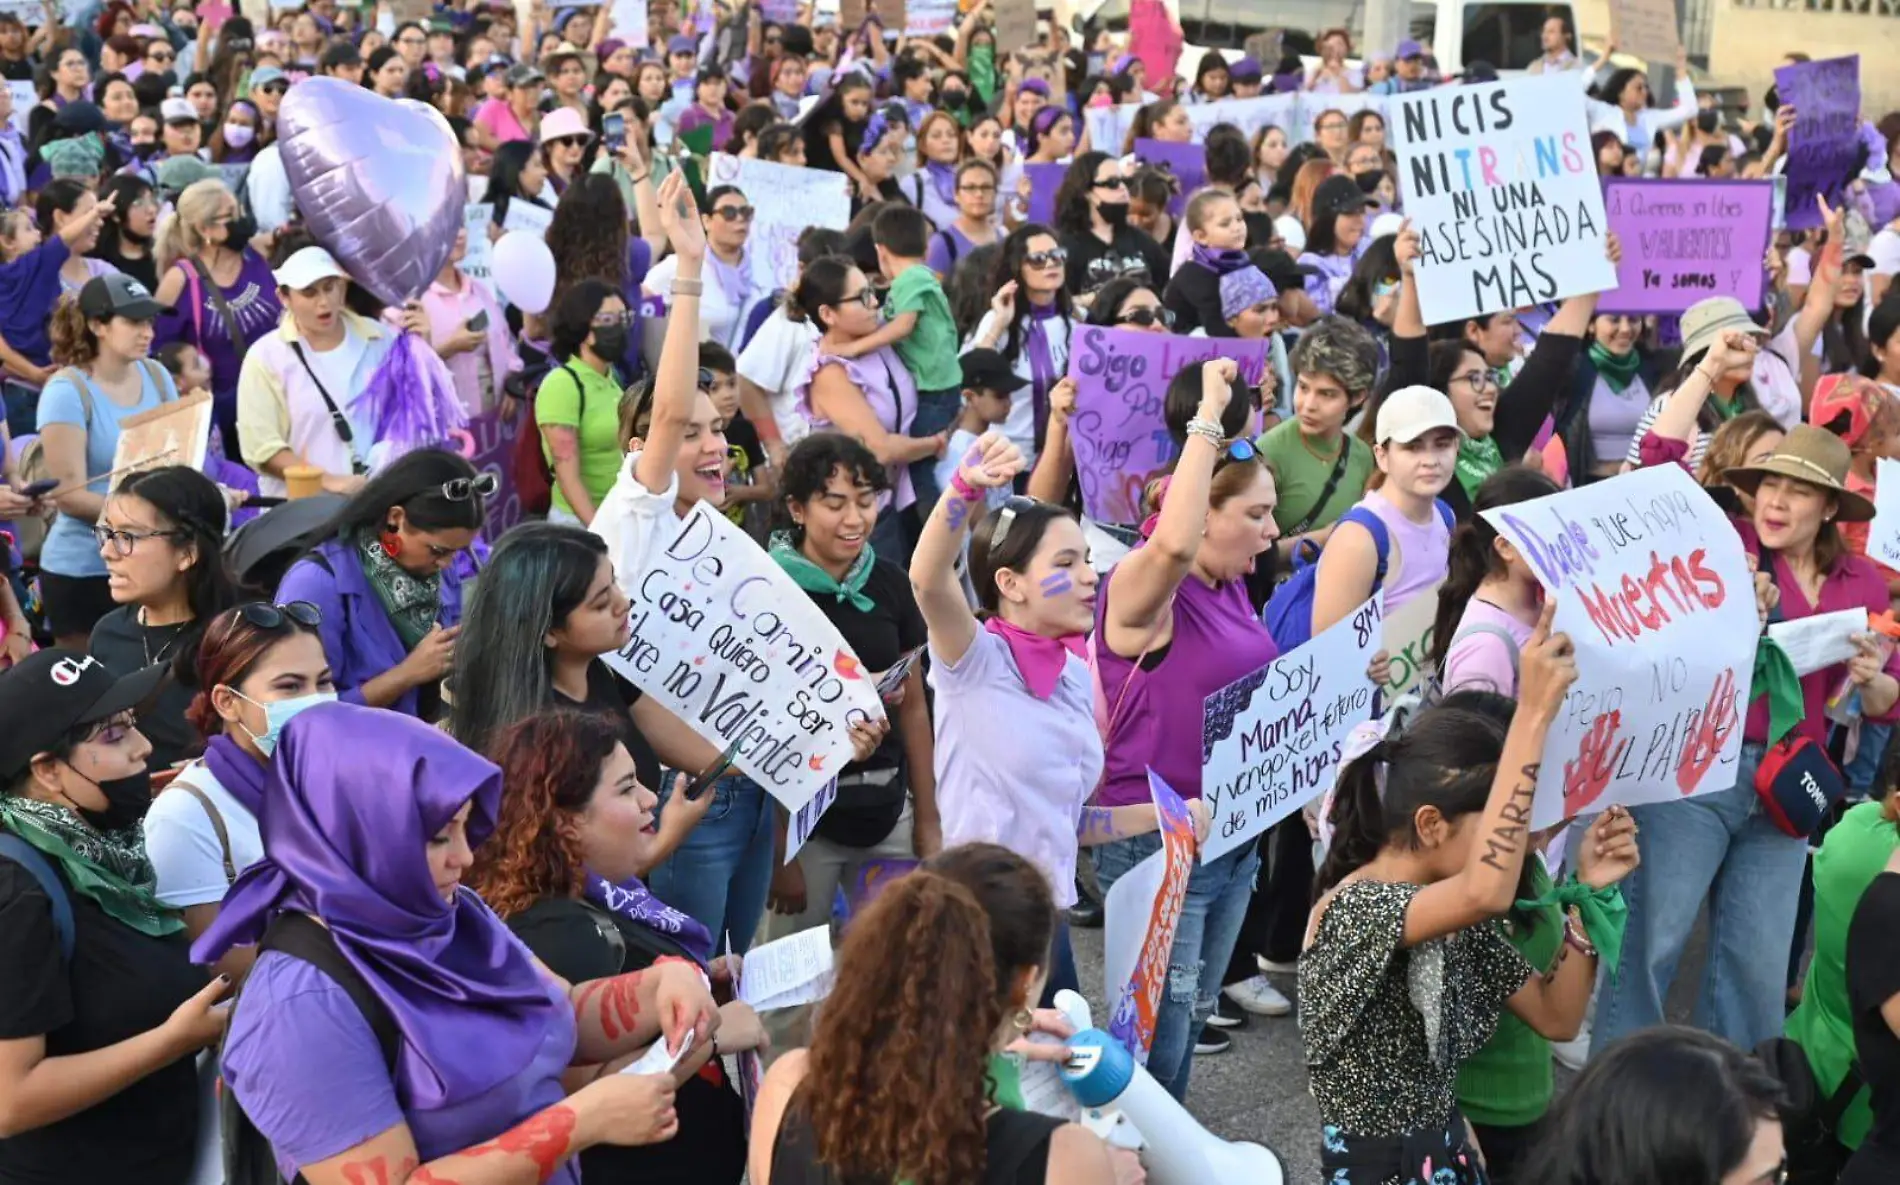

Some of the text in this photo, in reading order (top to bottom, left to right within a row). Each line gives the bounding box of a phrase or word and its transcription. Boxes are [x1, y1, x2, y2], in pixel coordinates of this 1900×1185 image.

[1402, 89, 1513, 143] NI CIS
[1410, 132, 1584, 198] NI TRANS
[1452, 181, 1545, 219] NI UNA
[1420, 199, 1597, 267] ASESINADA
[1473, 251, 1557, 313] MÁS
[1643, 269, 1660, 290] Ya
[1671, 271, 1716, 289] somos
[1079, 328, 1147, 393] Sigo
[1501, 506, 1600, 588] Duele
[1627, 490, 1698, 534] haya
[641, 569, 706, 632] Casa
[665, 508, 723, 586] De
[731, 576, 844, 703] Camino
[1353, 598, 1380, 649] 8M
[1650, 657, 1687, 704] NO
[662, 660, 702, 699] no
[700, 673, 803, 786] Valiente
[1563, 688, 1742, 798] CULPABLES
[1221, 740, 1342, 838] de mis hijas
